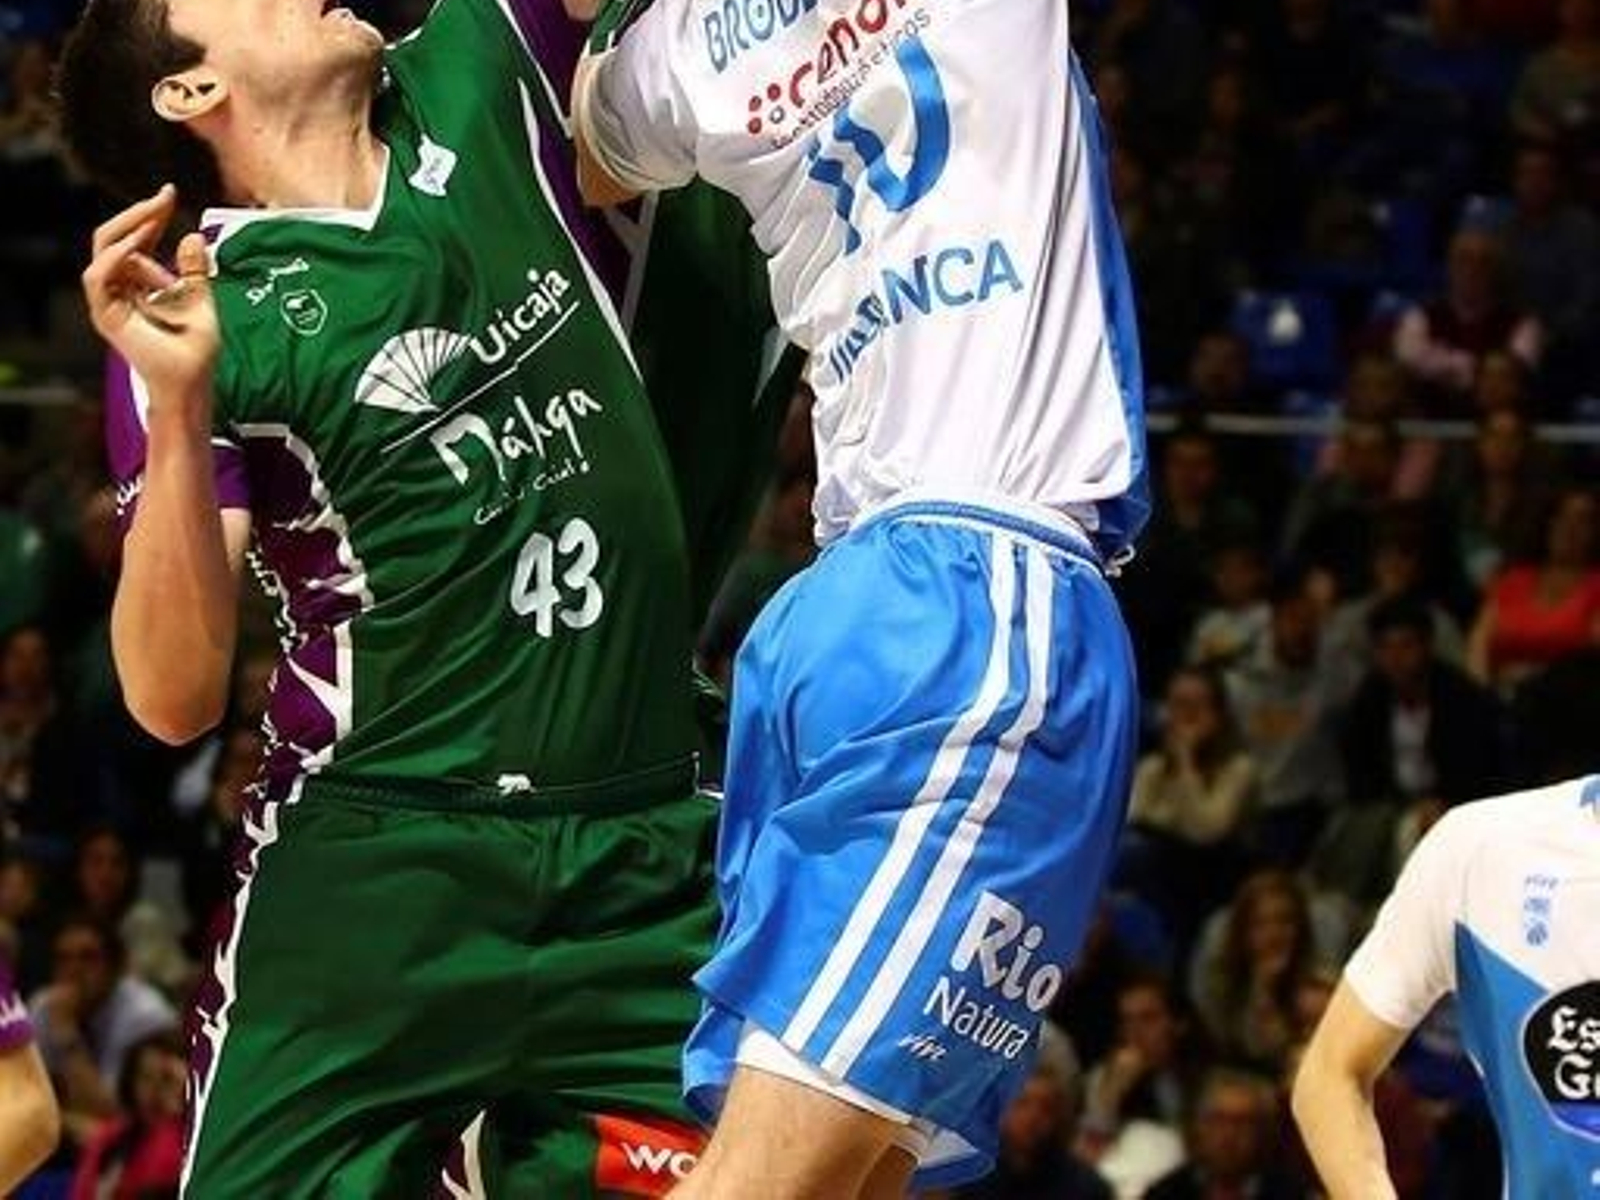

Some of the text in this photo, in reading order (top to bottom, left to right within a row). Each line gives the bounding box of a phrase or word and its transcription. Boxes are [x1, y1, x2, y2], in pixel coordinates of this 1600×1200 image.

[511, 518, 603, 638] 43
[951, 890, 1062, 1012] Rio
[923, 976, 1030, 1060] Natura
